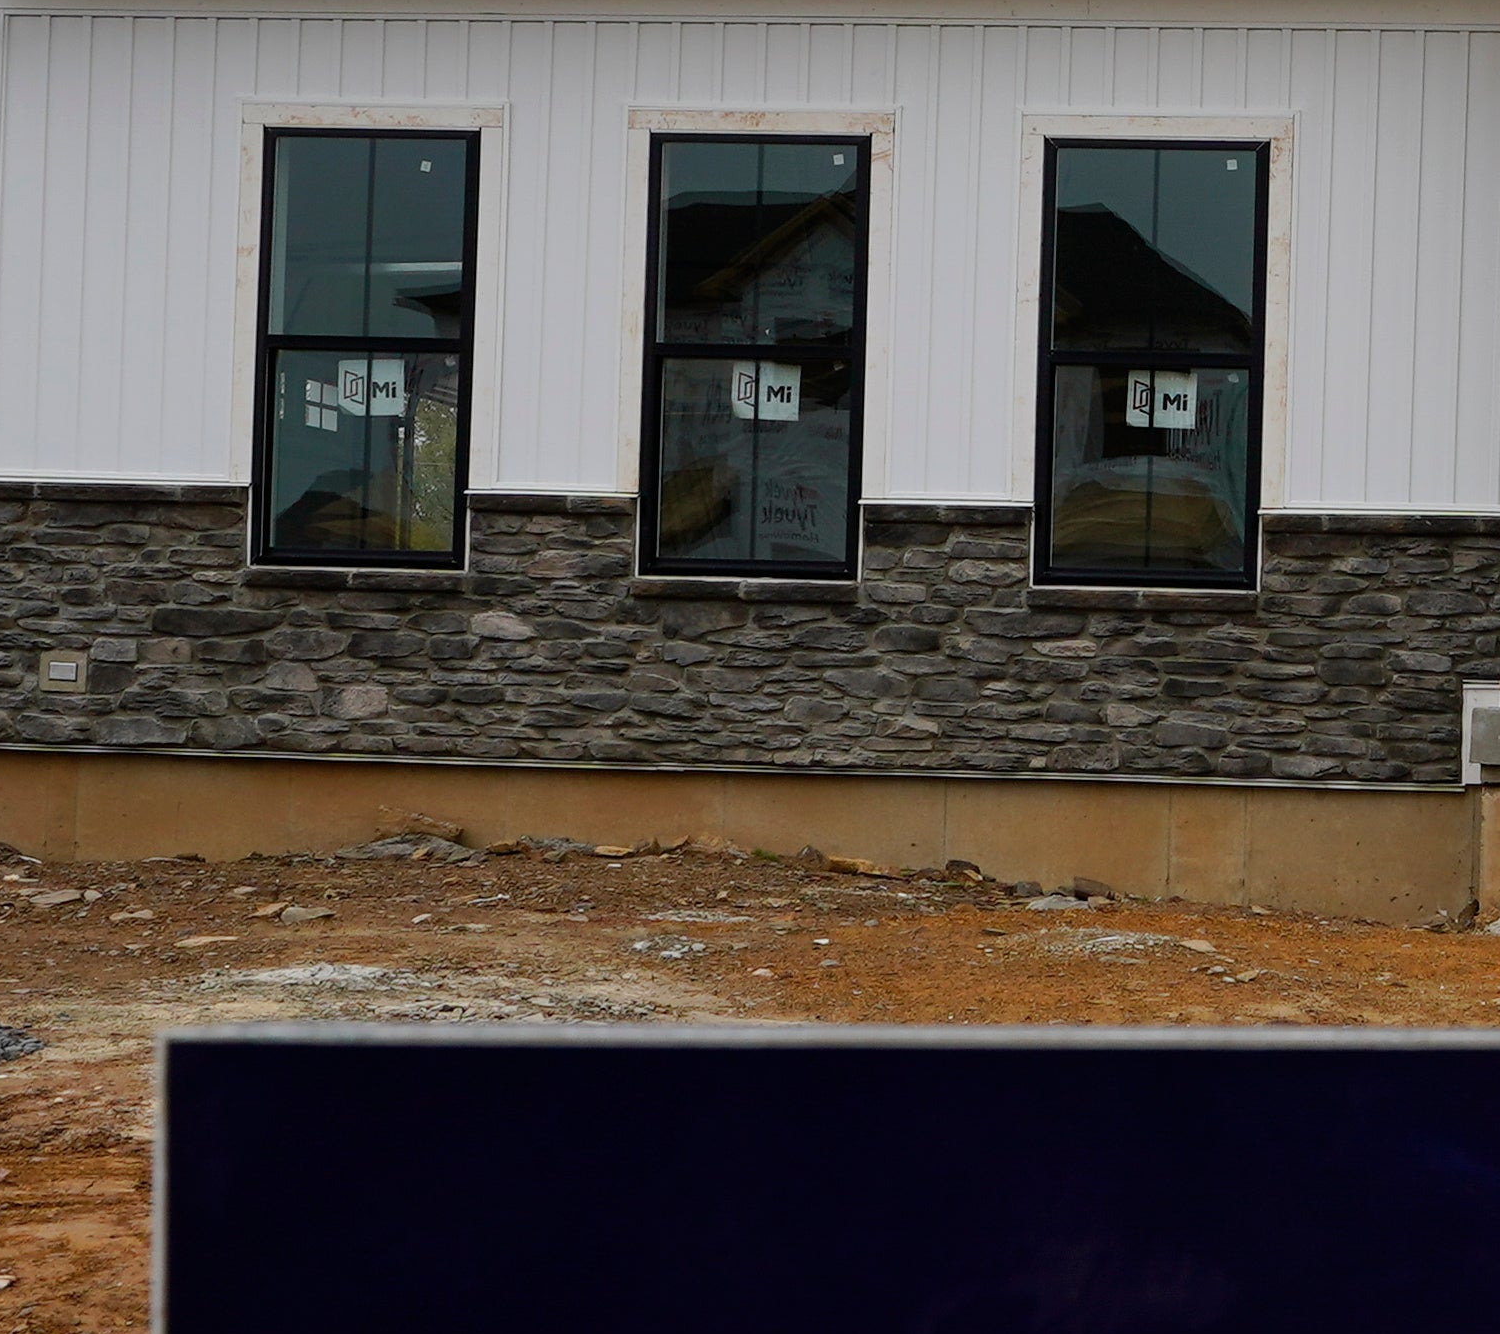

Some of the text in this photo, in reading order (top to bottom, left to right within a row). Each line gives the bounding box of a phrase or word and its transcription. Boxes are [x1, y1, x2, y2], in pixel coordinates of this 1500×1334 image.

[371, 380, 398, 400] Mi
[766, 384, 793, 404] Mi
[1162, 393, 1189, 412] Mi
